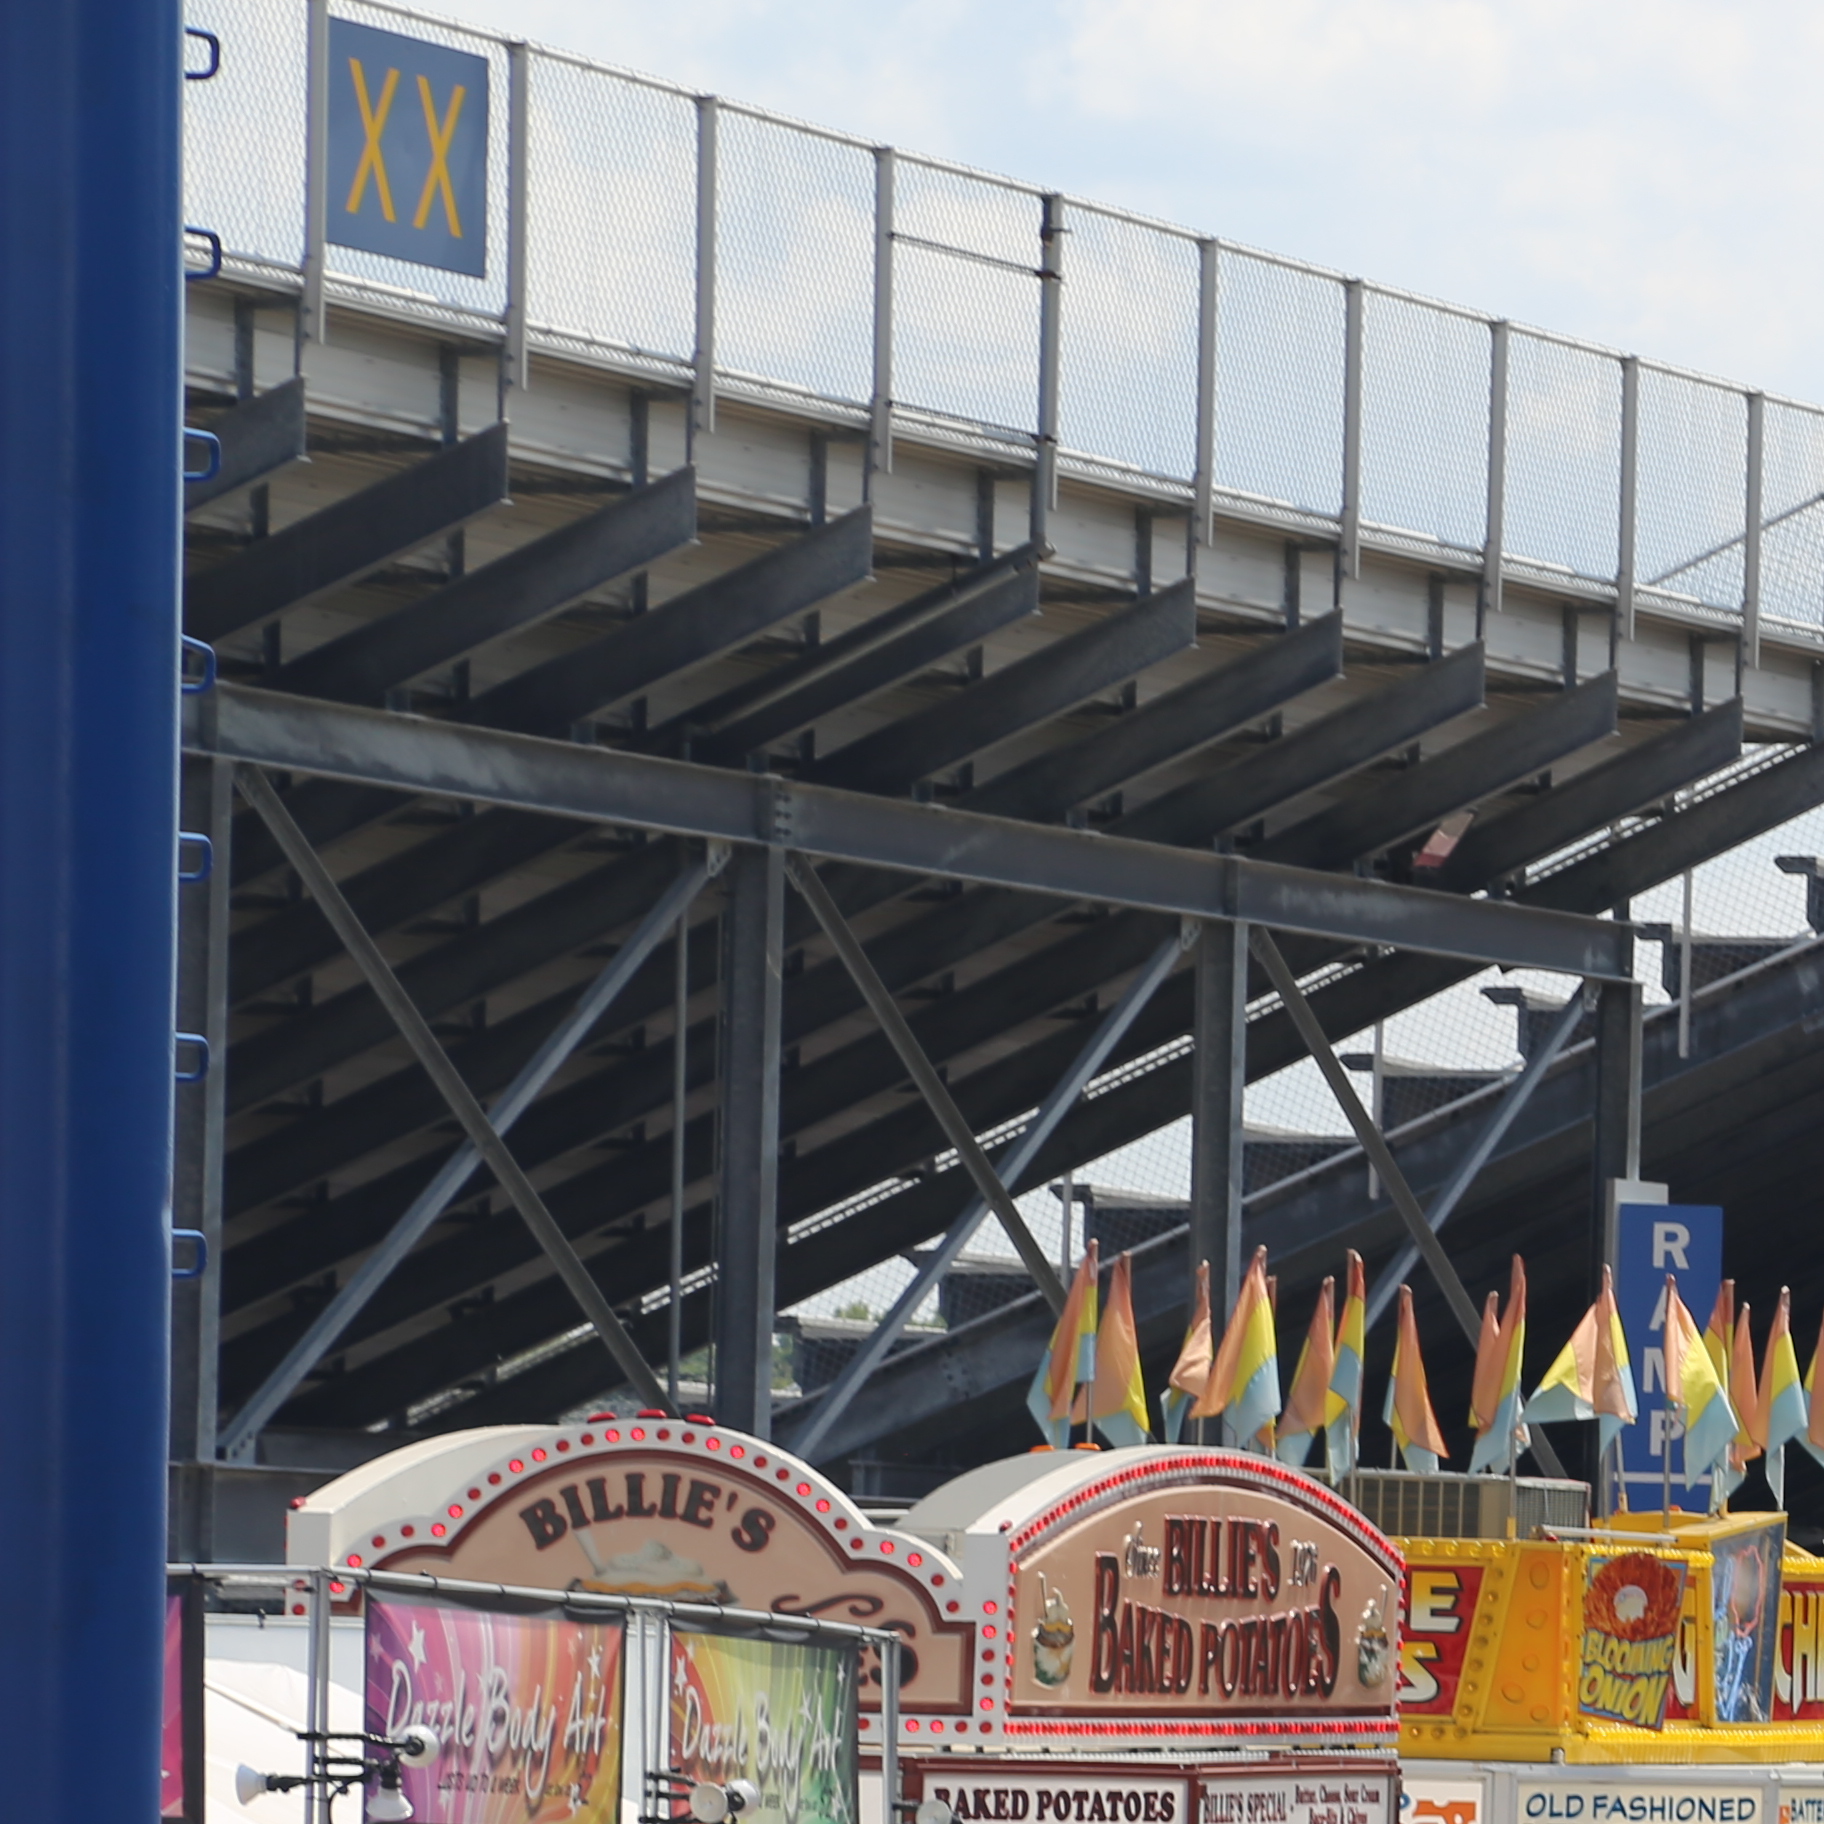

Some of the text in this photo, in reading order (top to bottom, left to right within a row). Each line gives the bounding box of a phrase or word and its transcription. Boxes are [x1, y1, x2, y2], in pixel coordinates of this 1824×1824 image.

[346, 57, 466, 238] XX
[519, 1472, 777, 1553] BILLIE'S
[1089, 1550, 1195, 1695] BAKED
[1198, 1562, 1341, 1700] POTATOES
[1583, 1628, 1674, 1674] BLOOMING
[386, 1658, 607, 1799] Dazzle Body Art
[1579, 1662, 1670, 1725] ONION
[682, 1686, 842, 1818] Dazzle Body Art
[1036, 1788, 1176, 1822] POTATOES
[1246, 1790, 1287, 1824] SPECIAL
[1526, 1793, 1756, 1822] OLD FASHIONED
